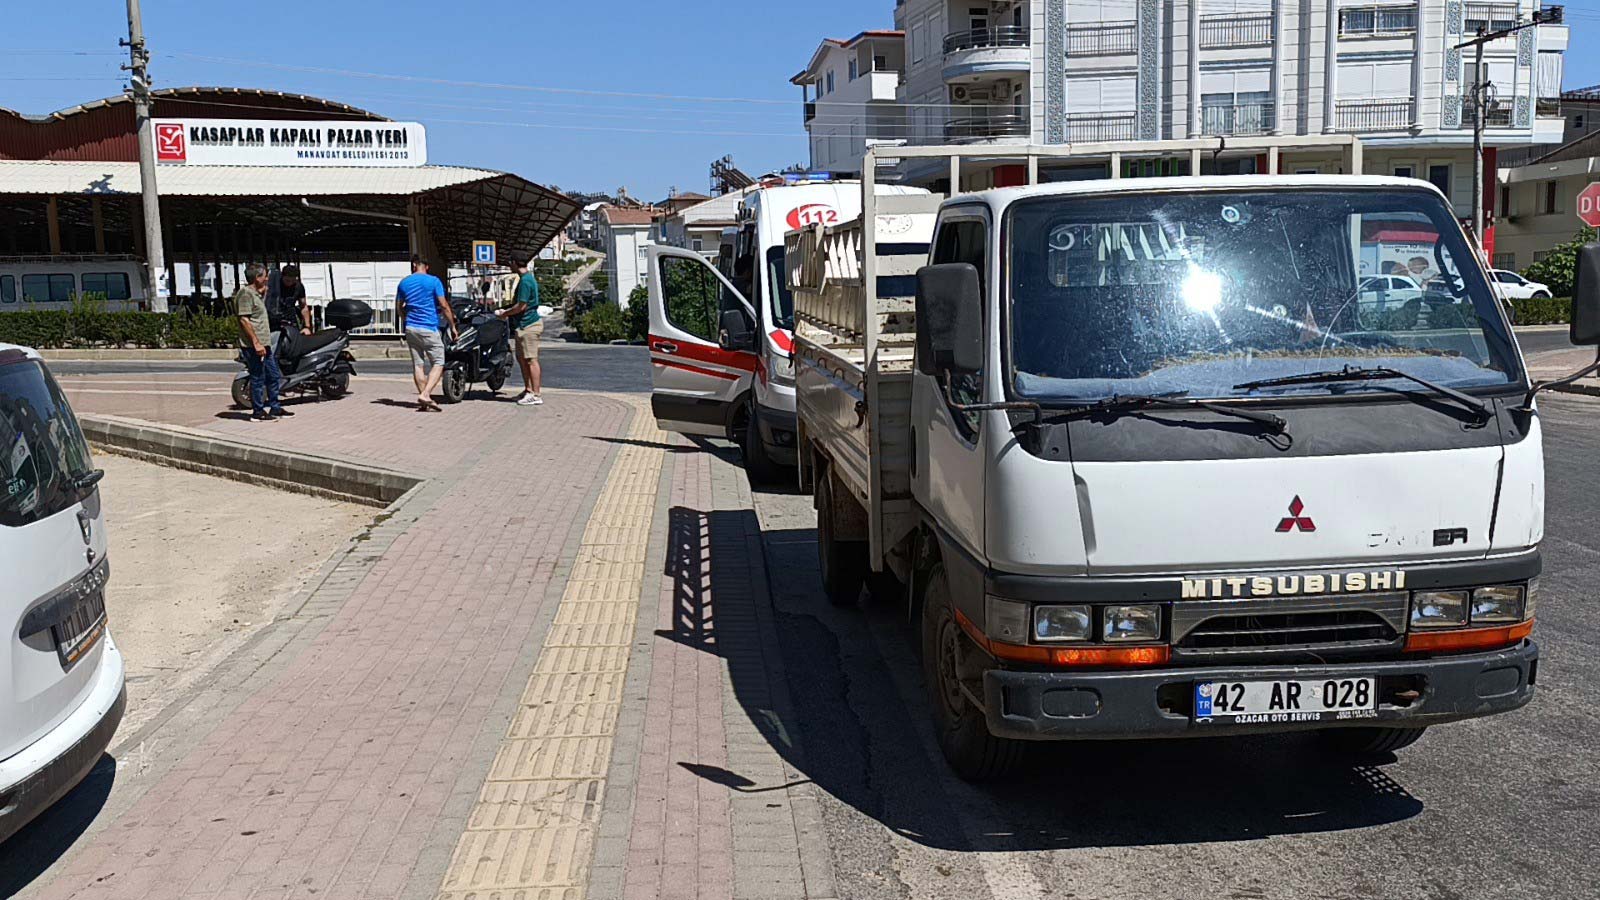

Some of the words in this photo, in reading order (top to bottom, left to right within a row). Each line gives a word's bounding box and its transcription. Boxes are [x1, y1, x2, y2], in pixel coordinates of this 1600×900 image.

[189, 126, 265, 146] KASAPLAR
[269, 127, 321, 147] KAPALI
[327, 128, 373, 148] PAZAR
[376, 126, 408, 148] YERİ
[389, 151, 408, 159] 2013
[801, 209, 838, 223] 112
[478, 245, 490, 261] H
[1180, 570, 1406, 598] MITSUBISHI
[1213, 683, 1246, 712] 42
[1268, 680, 1302, 710] AR
[1322, 678, 1370, 709] 028
[1199, 700, 1211, 710] TR
[1271, 714, 1288, 722] OTO
